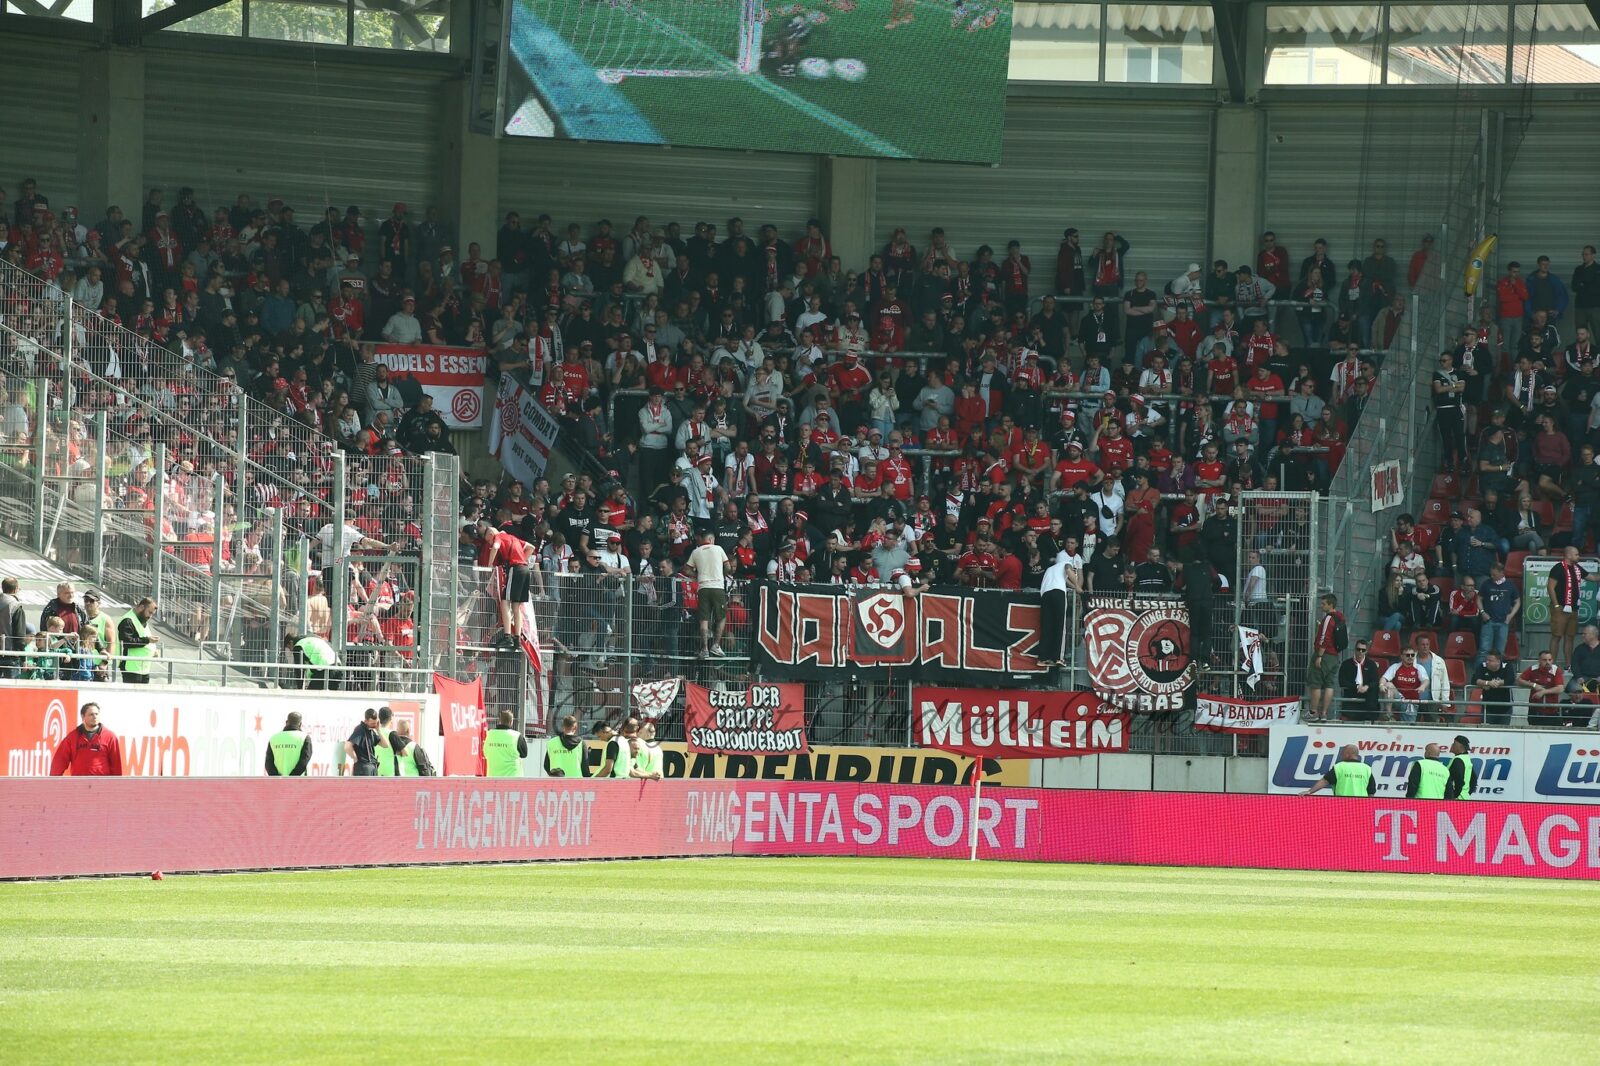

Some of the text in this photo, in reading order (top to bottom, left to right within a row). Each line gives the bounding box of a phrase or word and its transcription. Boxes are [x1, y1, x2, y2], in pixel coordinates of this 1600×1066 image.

[439, 355, 487, 375] ESSEN
[523, 401, 557, 441] COMBAT
[1088, 598, 1131, 610] JUNGE
[752, 686, 780, 707] DER
[1208, 703, 1224, 718] LA
[1228, 704, 1274, 720] BANDA
